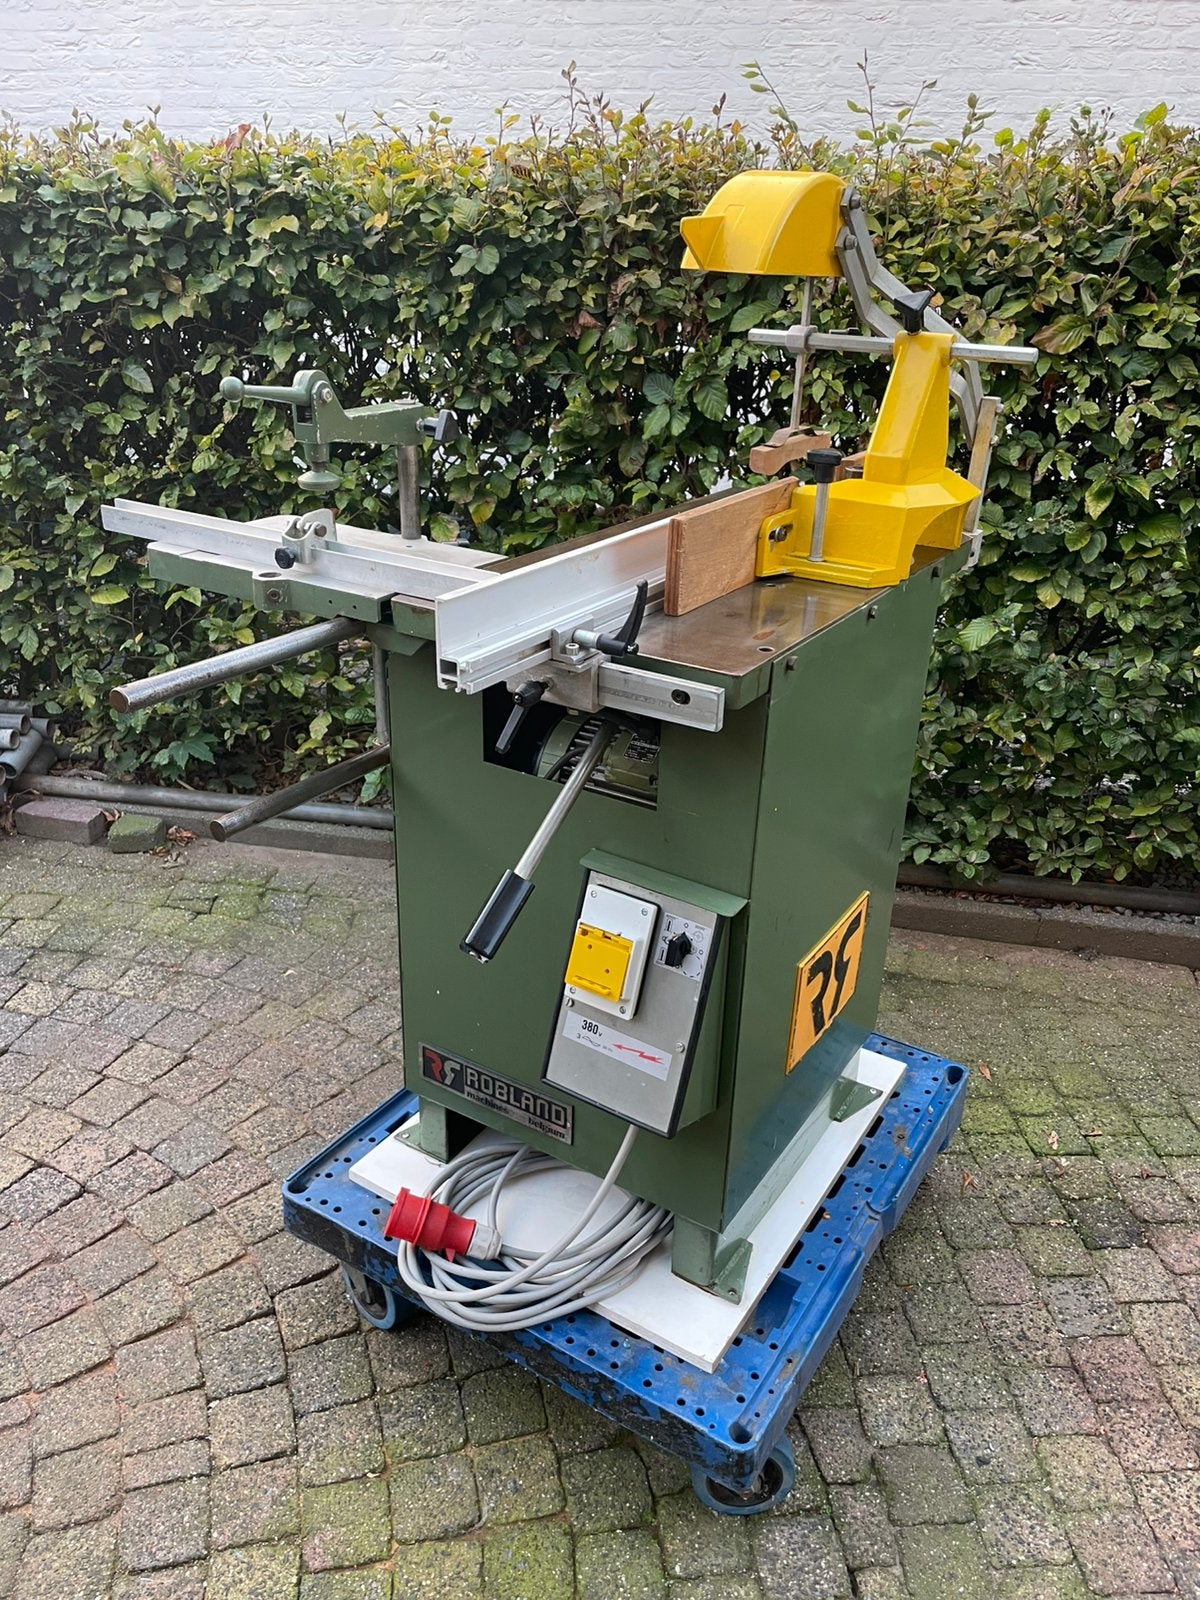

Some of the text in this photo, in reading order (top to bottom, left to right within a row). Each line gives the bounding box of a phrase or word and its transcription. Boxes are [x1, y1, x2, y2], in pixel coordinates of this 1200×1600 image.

[466, 1067, 566, 1126] ROBLAND
[466, 1091, 565, 1139] machines belgium
